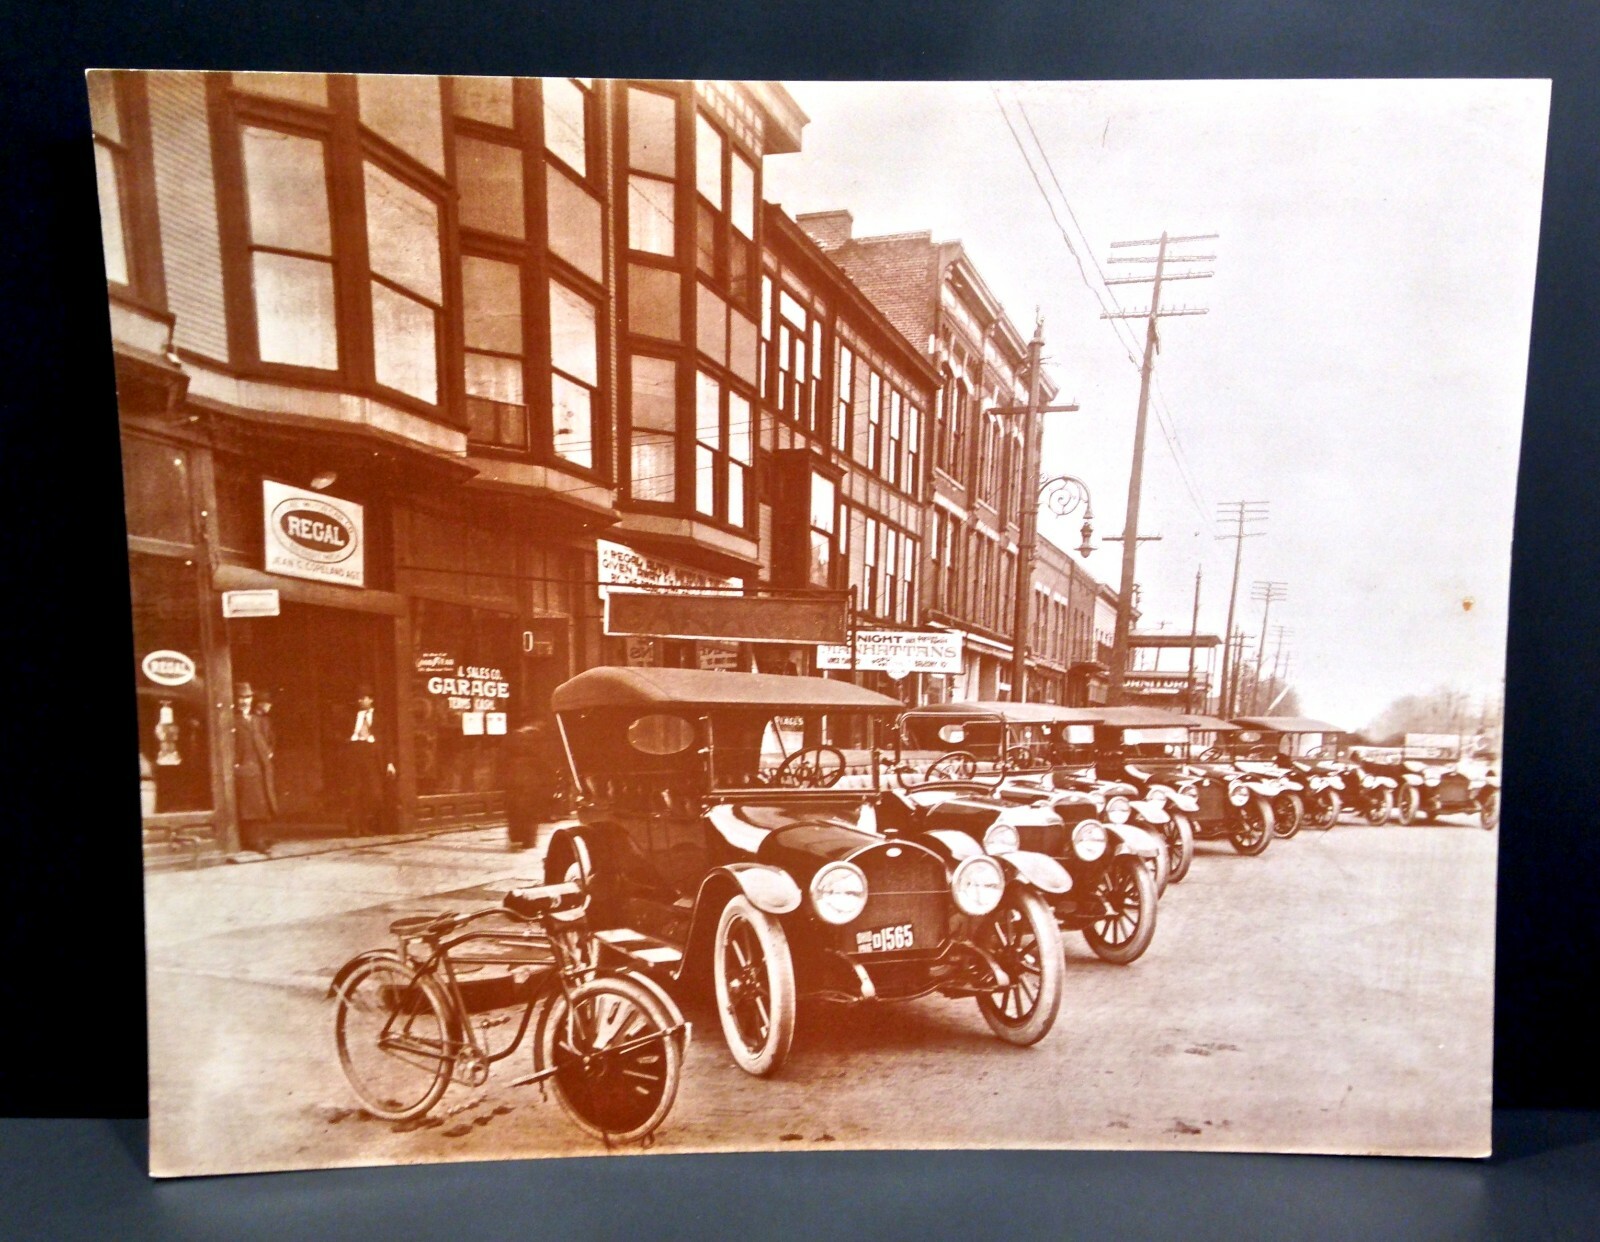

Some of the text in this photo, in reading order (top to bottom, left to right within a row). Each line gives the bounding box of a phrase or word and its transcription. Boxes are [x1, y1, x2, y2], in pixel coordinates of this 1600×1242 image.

[287, 515, 345, 547] REGAL
[857, 634, 904, 644] NIGHT
[466, 666, 490, 680] SALES
[427, 676, 510, 698] GARAGE
